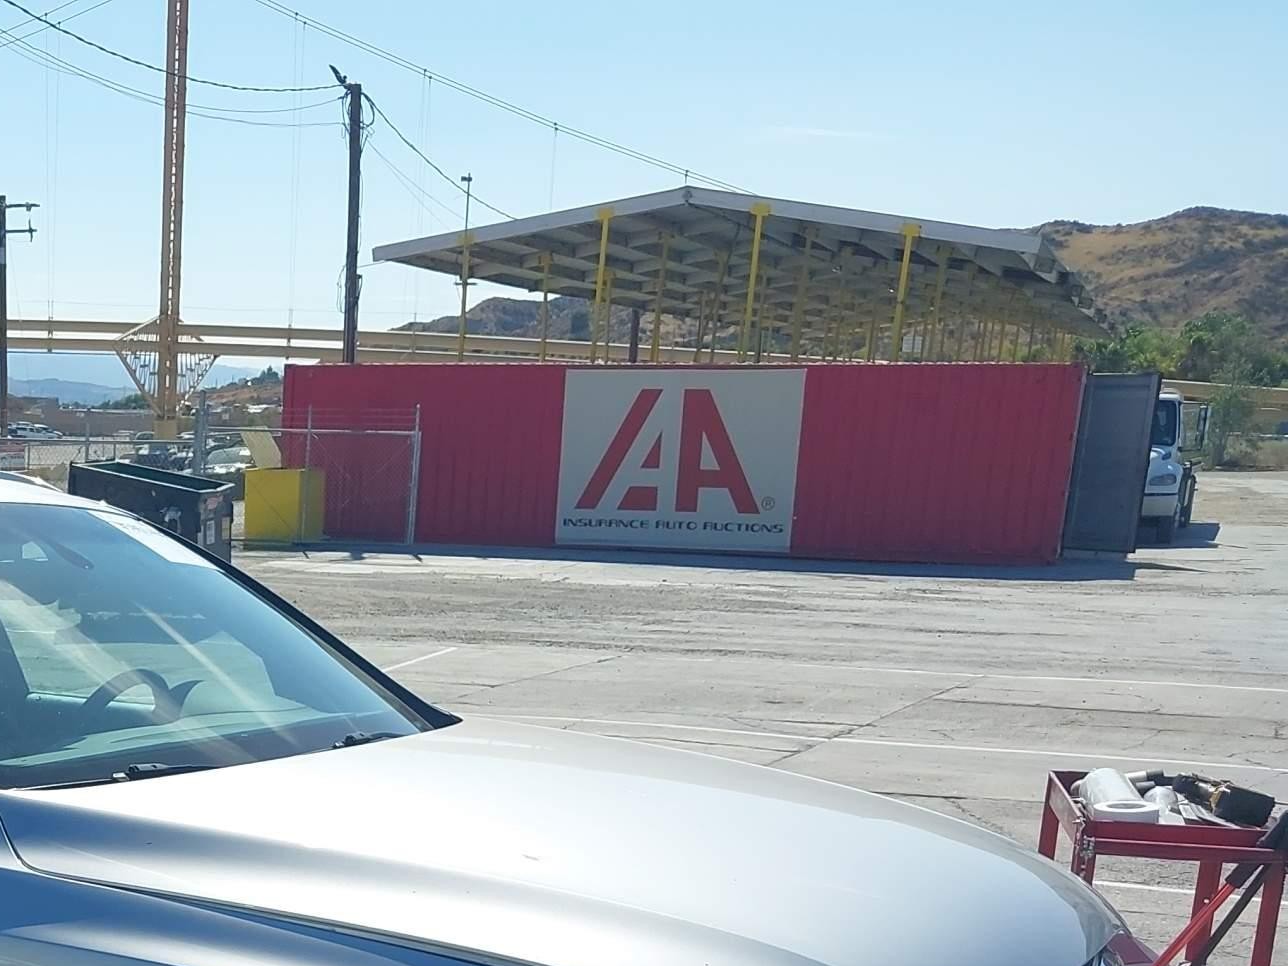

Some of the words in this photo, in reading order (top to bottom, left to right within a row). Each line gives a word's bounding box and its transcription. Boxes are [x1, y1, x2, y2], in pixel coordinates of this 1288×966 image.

[562, 518, 649, 529] INSURANCE
[655, 520, 697, 531] AUTO
[703, 521, 784, 533] AUCTIONS
